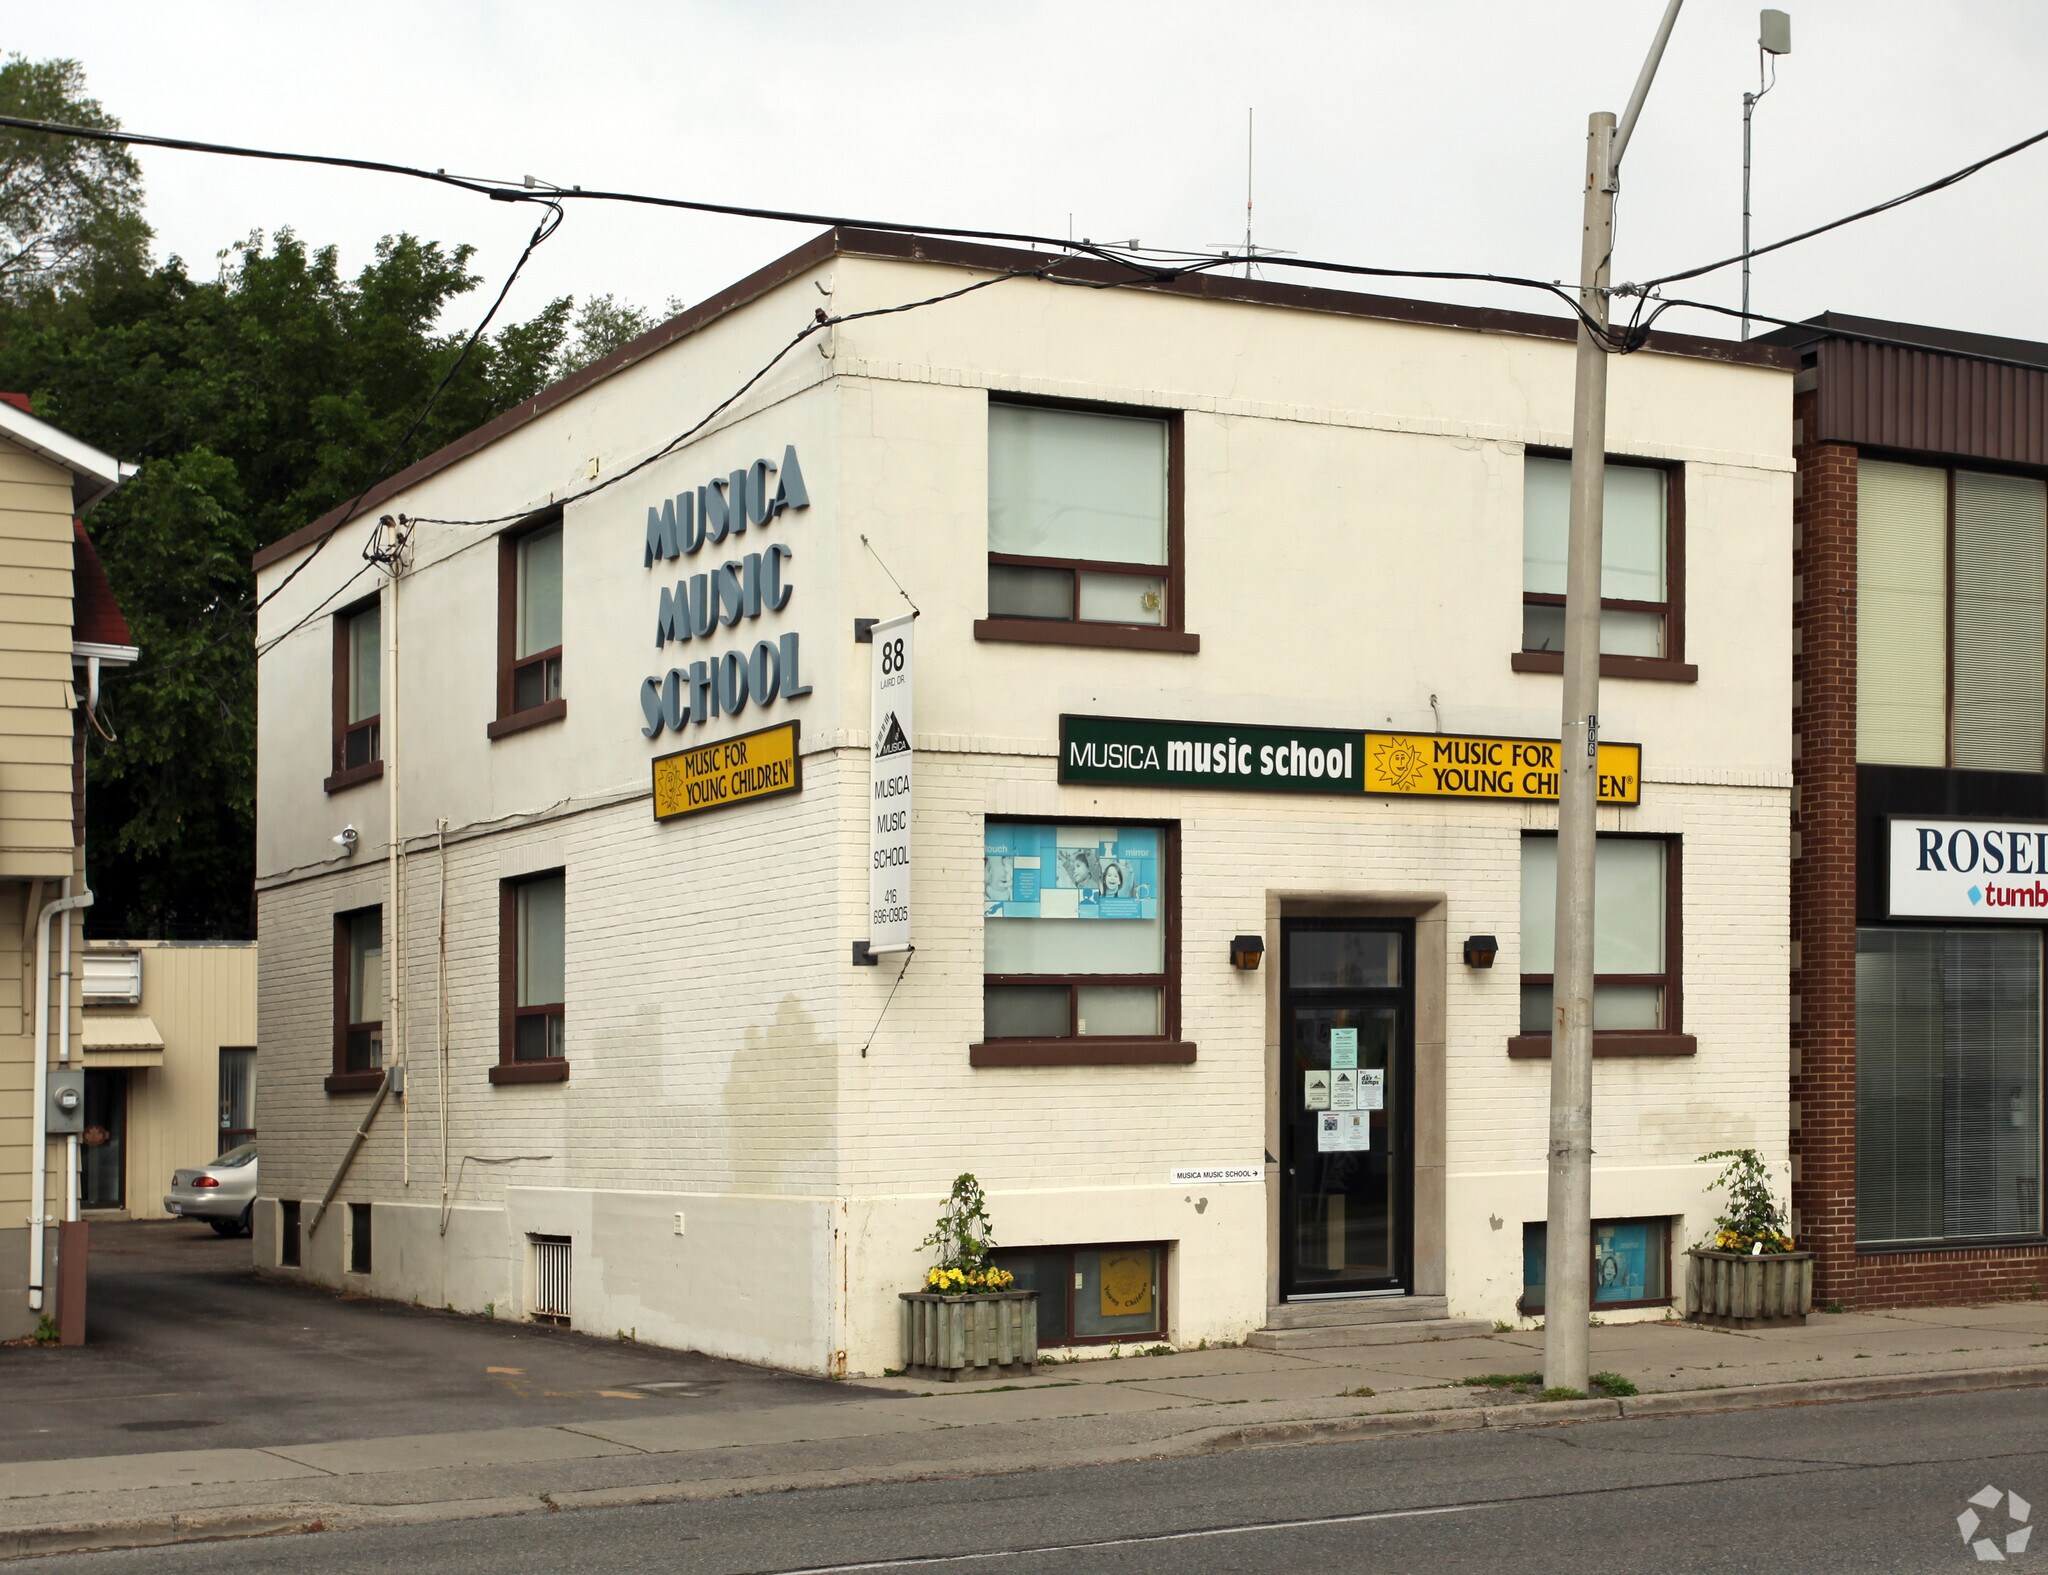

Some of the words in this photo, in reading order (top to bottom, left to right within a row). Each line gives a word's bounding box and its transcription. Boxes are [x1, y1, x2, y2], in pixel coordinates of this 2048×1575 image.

[644, 444, 810, 568] MUSICA
[656, 543, 793, 648] MUSIC
[882, 638, 905, 676] 88
[641, 631, 812, 739] SCHOOL
[880, 677, 896, 690] LAIRD
[684, 747, 721, 779] MUSIC
[724, 741, 748, 768] FOR
[883, 741, 907, 754] MUSICA
[1070, 741, 1160, 770] MUSICA
[1166, 736, 1252, 775] music
[1259, 740, 1353, 779] school
[1433, 740, 1503, 766] MUSIC
[1511, 745, 1555, 768] FOR
[685, 775, 728, 806] YOUNG
[874, 774, 910, 800] MUSICA
[1433, 768, 1514, 793] YOUNG
[877, 810, 907, 834] MUSIC
[873, 845, 910, 870] SCHOOL
[1125, 848, 1149, 857] mirror
[884, 888, 897, 904] 416
[873, 905, 908, 925] 696-0905
[1176, 1171, 1202, 1179] MUSICA
[1225, 1170, 1251, 1178] SCHOOL
[1104, 1285, 1119, 1306] Young
[1125, 1283, 1147, 1307] Children
